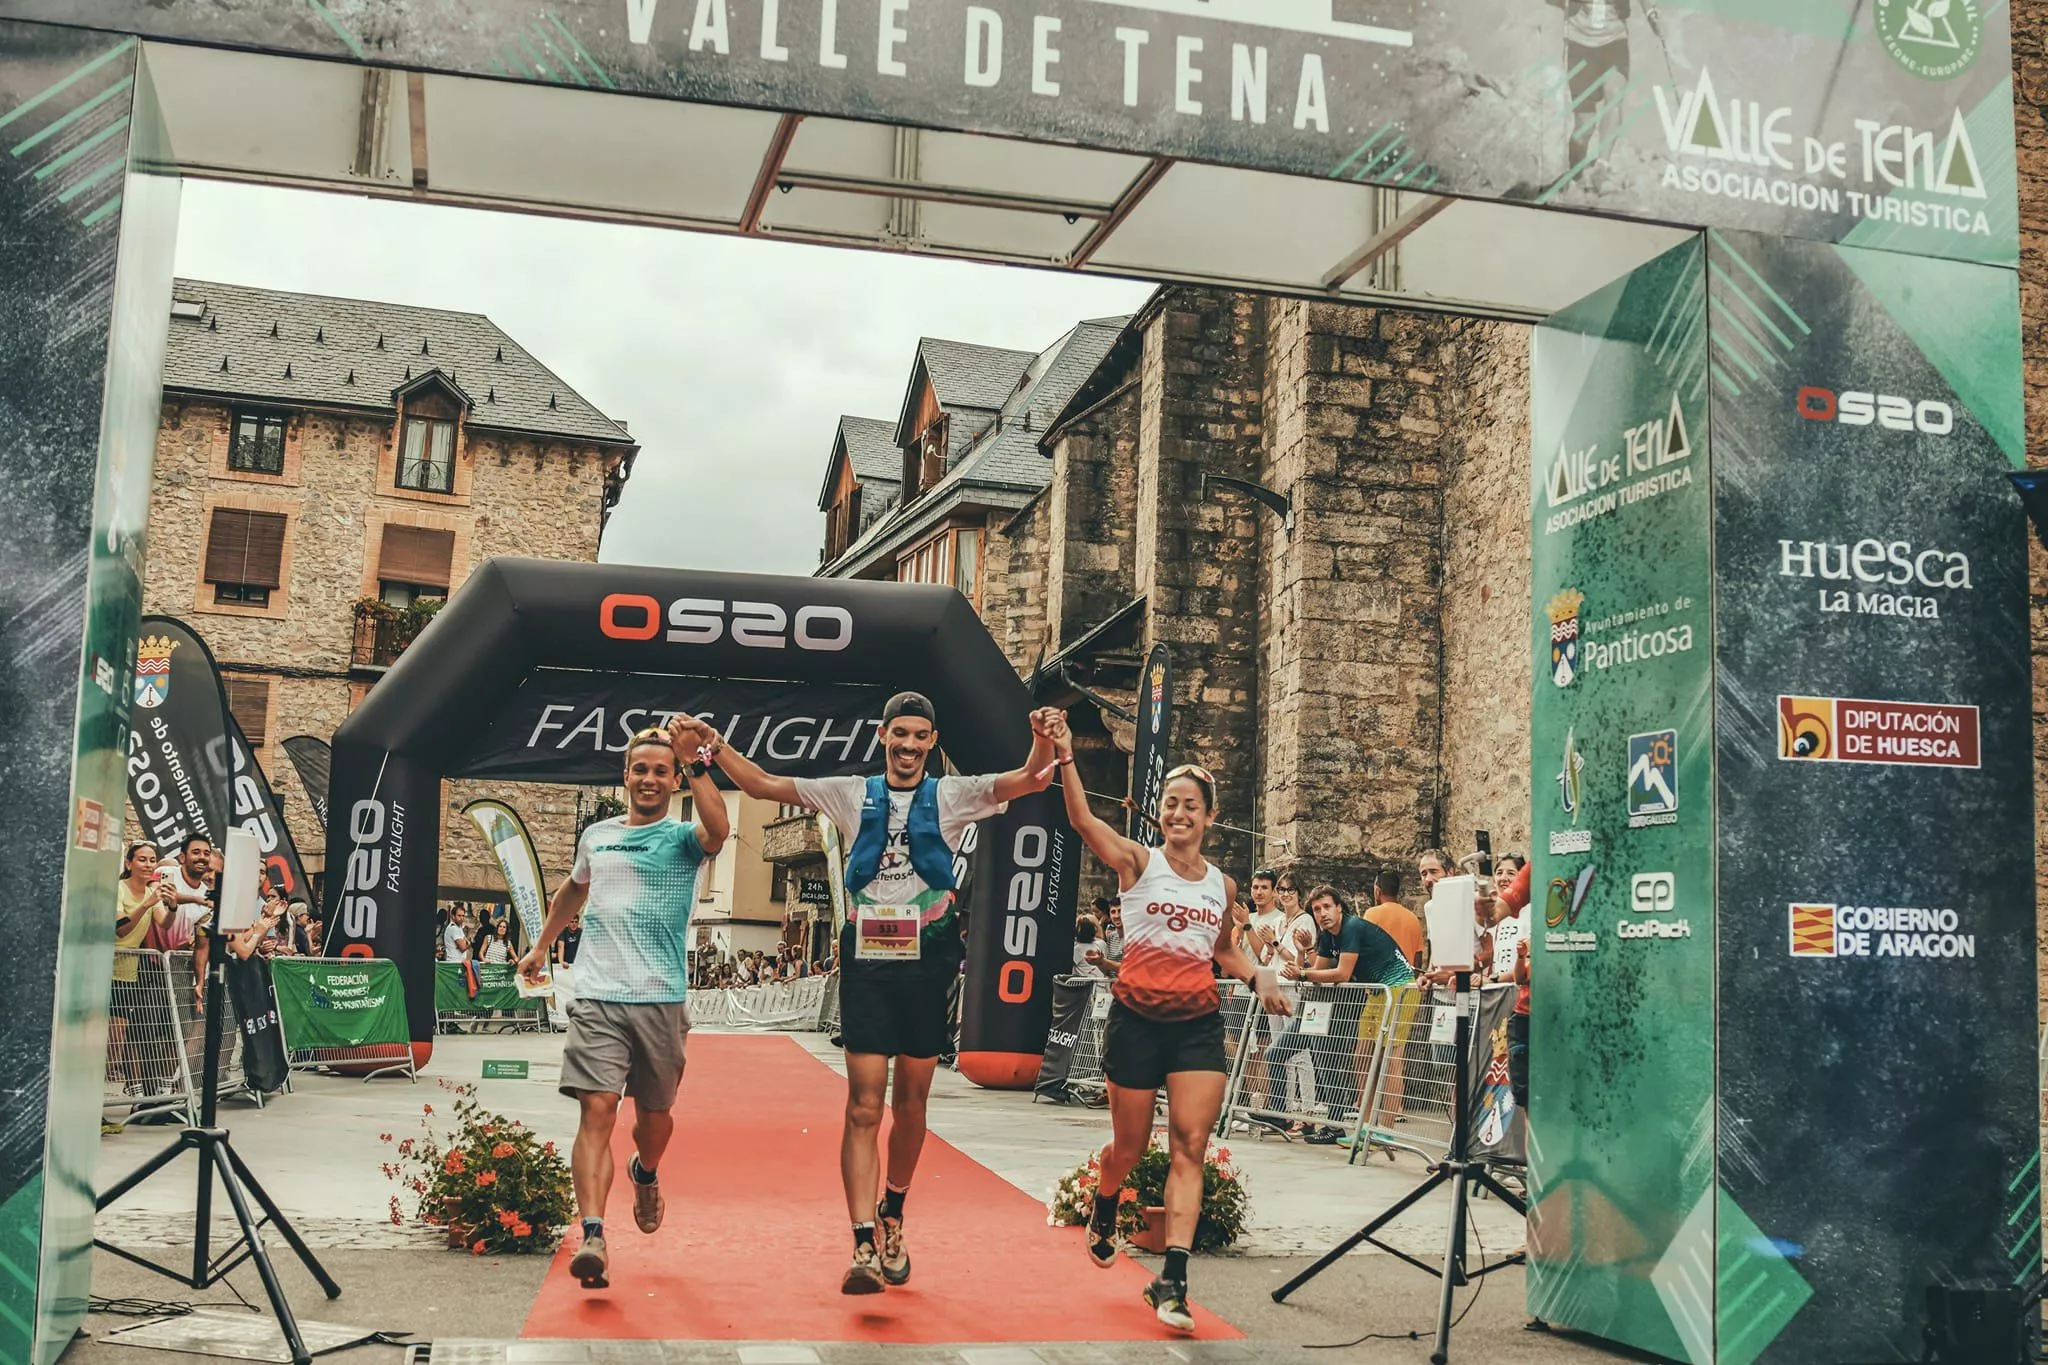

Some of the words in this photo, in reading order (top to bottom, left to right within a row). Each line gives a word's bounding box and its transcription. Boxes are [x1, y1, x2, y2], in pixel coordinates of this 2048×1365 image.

[626, 0, 910, 77] VALLE
[964, 6, 1062, 97] DE
[1115, 27, 1330, 133] TENA
[1661, 163, 1840, 214] ASOCIACION
[1846, 191, 1991, 236] TURISTICA
[1545, 494, 1618, 536] ASOCIACION
[1618, 465, 1693, 507] TURISTICA
[1584, 605, 1669, 635] Ayuntamiento
[1674, 596, 1692, 610] de
[1584, 623, 1693, 673] Panticosa
[1844, 709, 1960, 735] DIPUTACIÓN
[1846, 735, 1874, 754] DE
[1877, 736, 1961, 759] HUESCA
[387, 800, 406, 893] FAST&LIGHT
[606, 845, 650, 853] SCARPA
[1046, 828, 1065, 916] FAST&LIGHT
[879, 924, 898, 933] 533
[1837, 906, 1959, 931] GOBIERNO
[1837, 933, 1871, 956] DE
[1877, 934, 1975, 958] ARAGON
